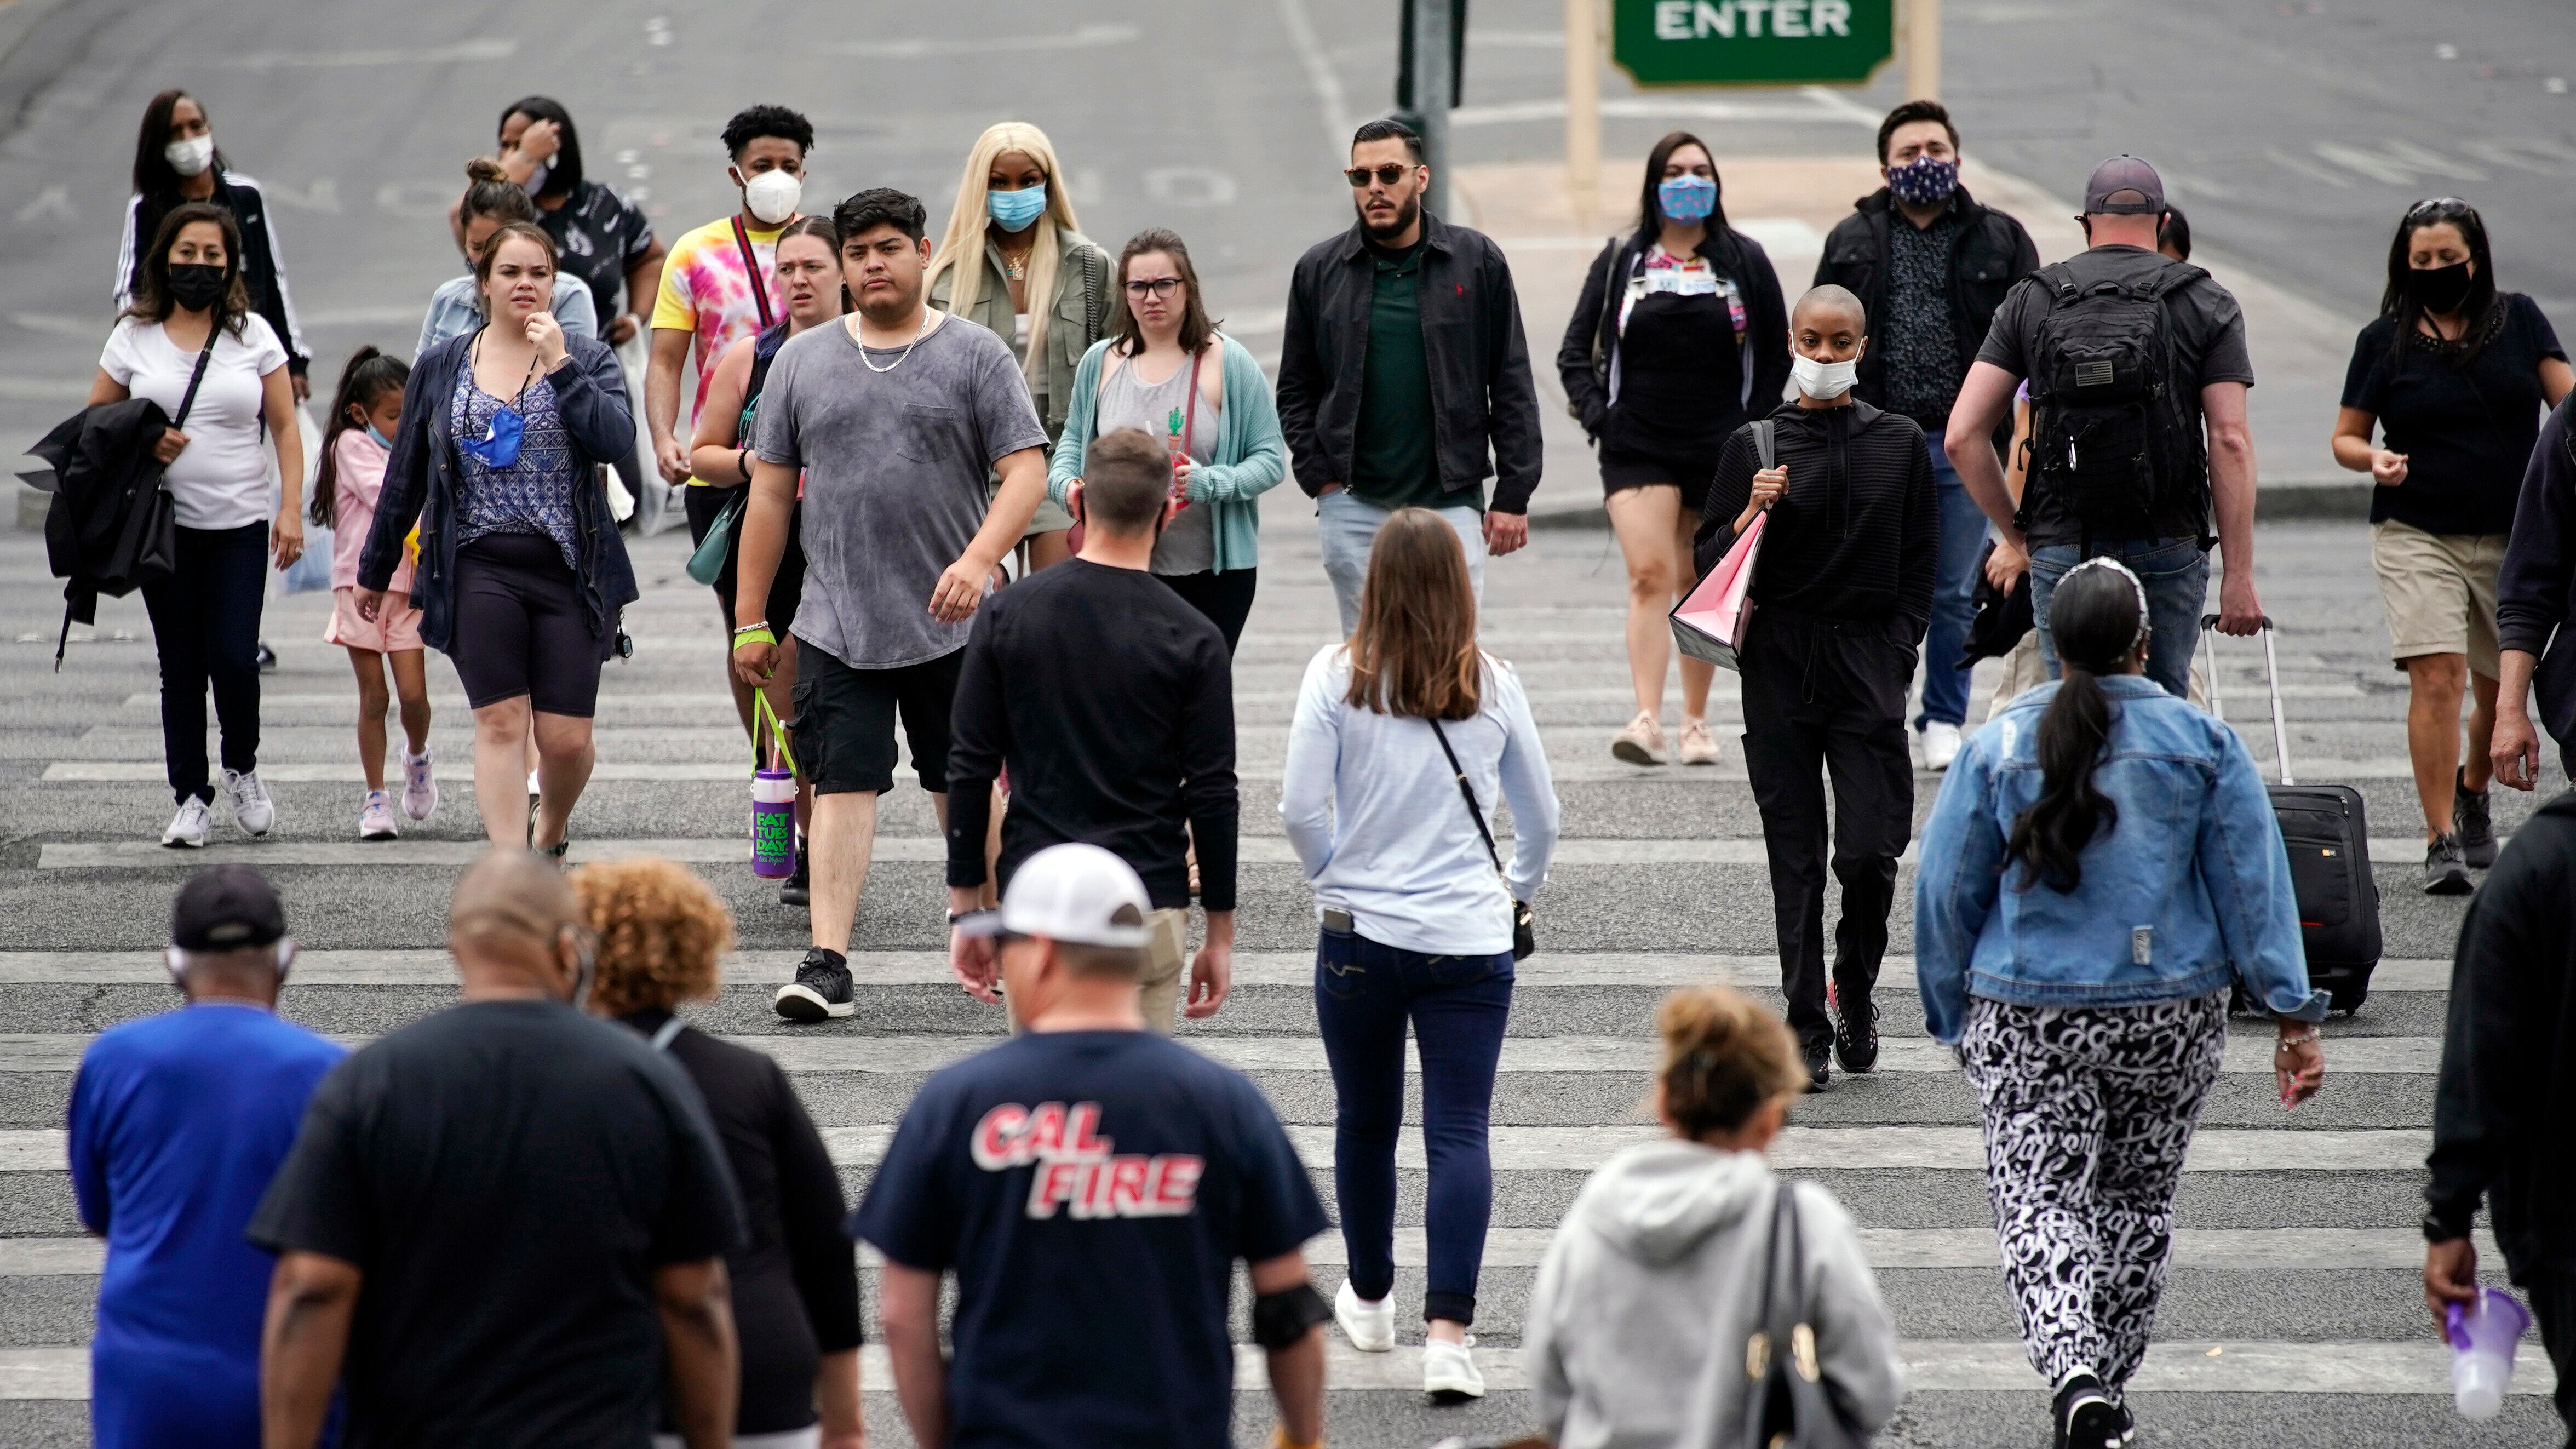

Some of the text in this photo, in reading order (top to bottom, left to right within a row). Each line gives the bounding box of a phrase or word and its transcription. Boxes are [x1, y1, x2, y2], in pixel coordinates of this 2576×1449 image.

[1655, 0, 1852, 39] ENTER
[756, 812, 789, 827] FAT
[756, 827, 788, 839] TUES
[756, 839, 788, 851] DAY
[768, 856, 785, 866] Vegas
[970, 1101, 1115, 1171] CAL
[1025, 1153, 1206, 1221] FIRE
